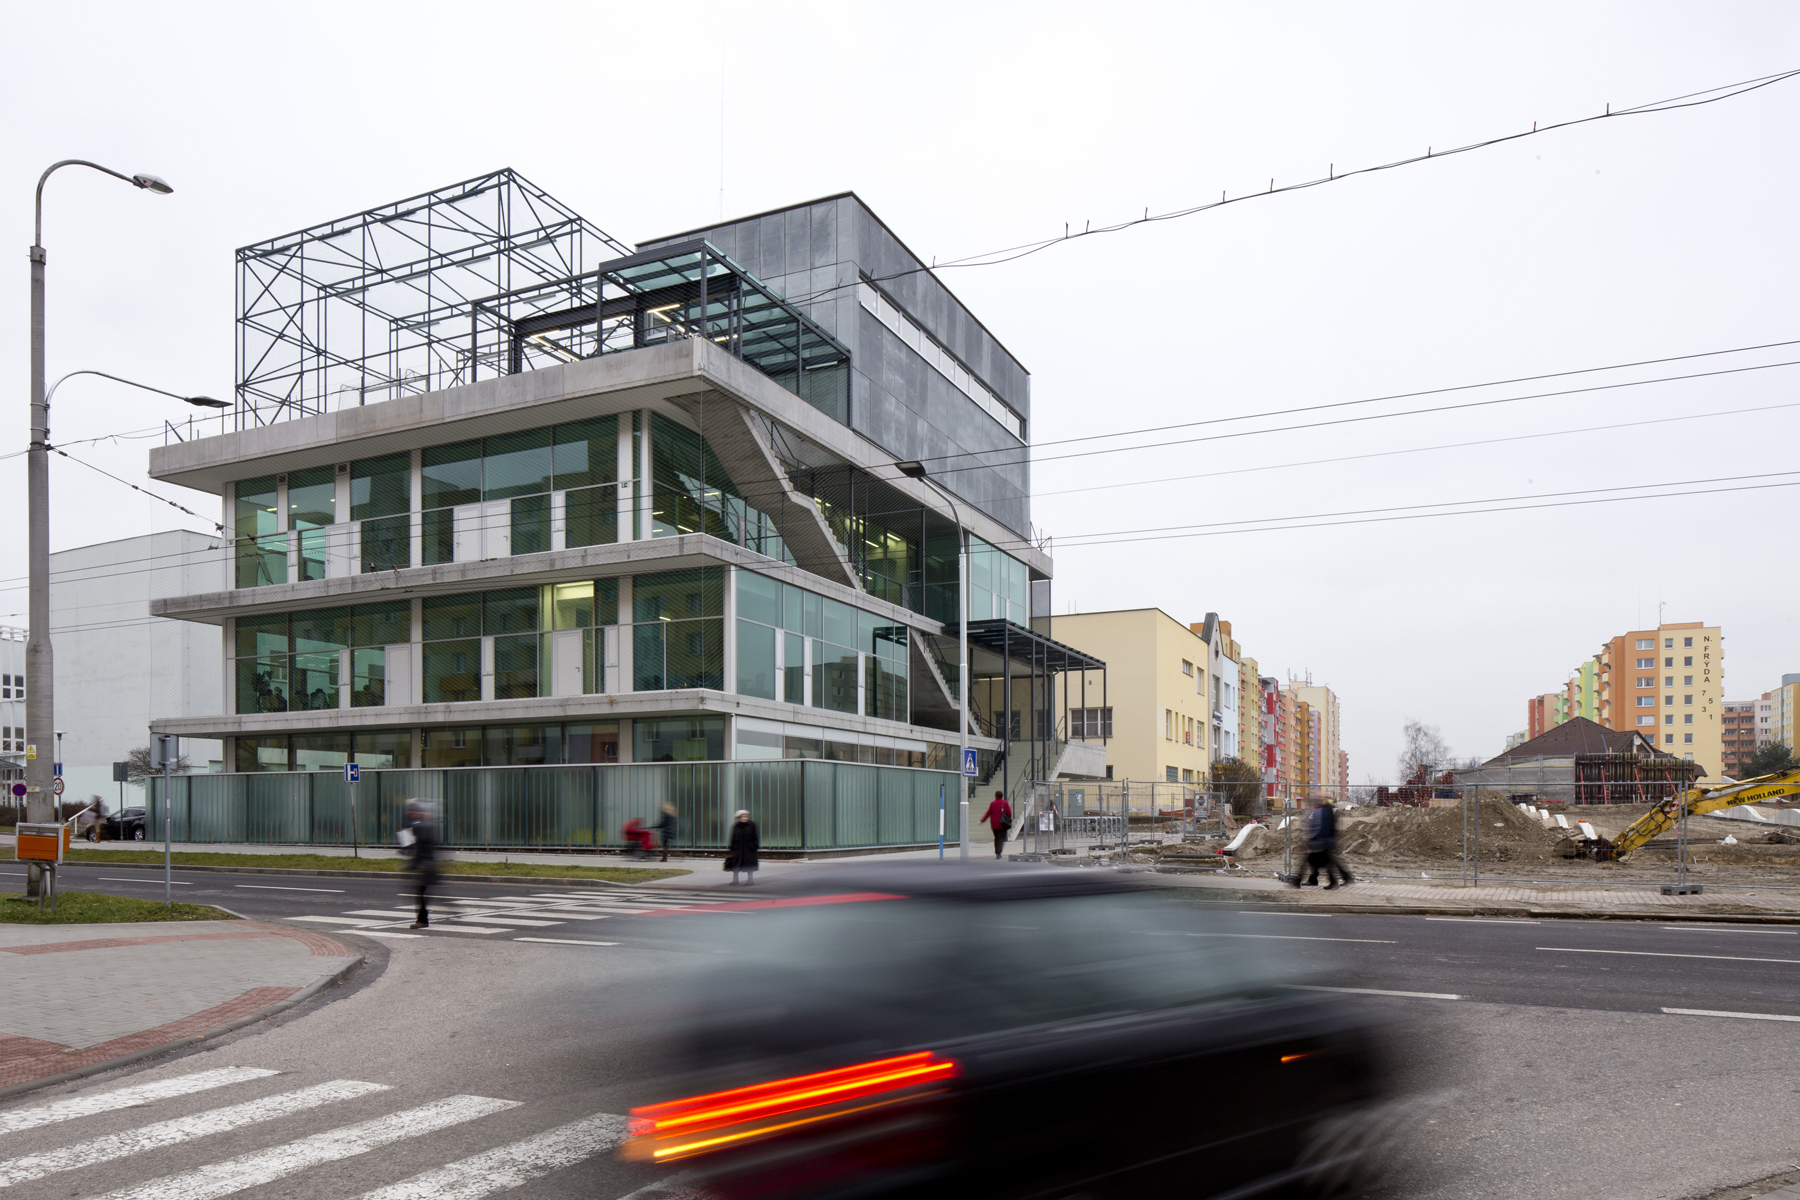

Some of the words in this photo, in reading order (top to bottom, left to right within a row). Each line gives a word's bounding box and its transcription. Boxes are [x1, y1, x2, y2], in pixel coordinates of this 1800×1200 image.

[54, 782, 61, 791] 20
[1727, 796, 1746, 806] NEW
[1746, 788, 1785, 801] HOLLAND
